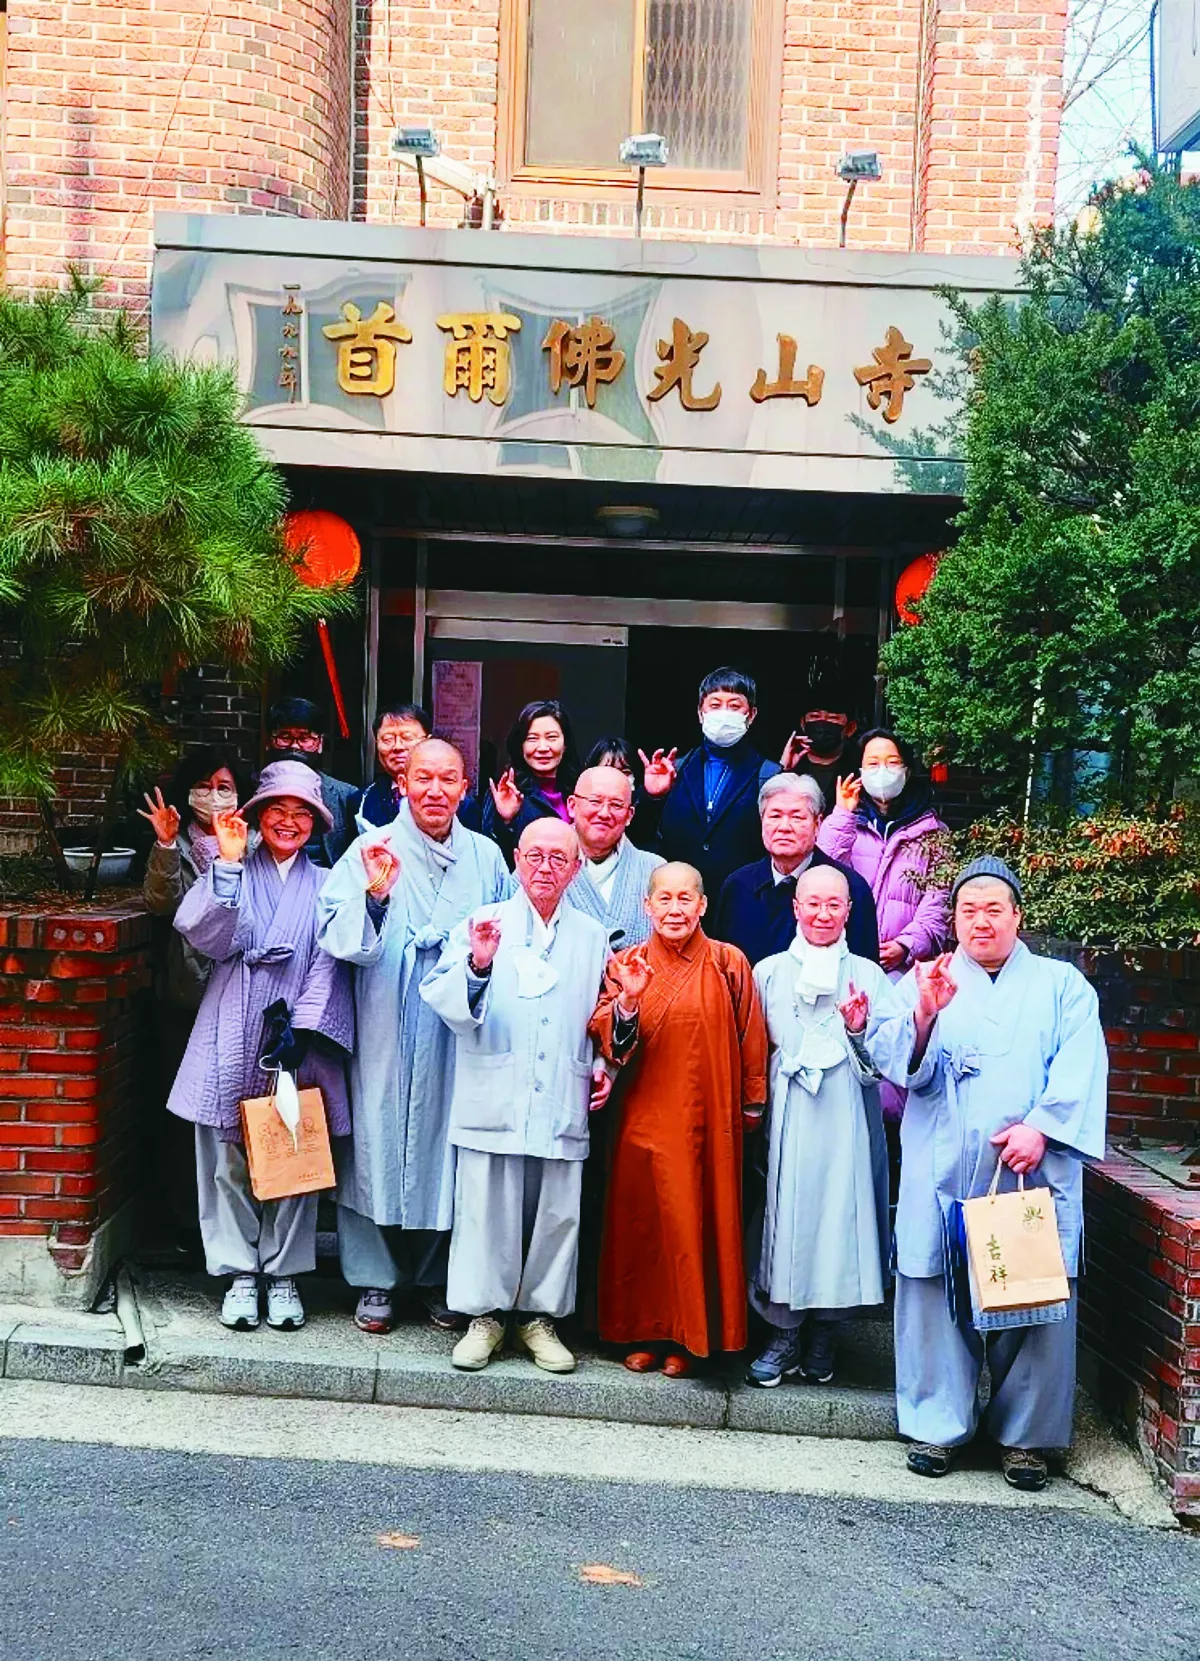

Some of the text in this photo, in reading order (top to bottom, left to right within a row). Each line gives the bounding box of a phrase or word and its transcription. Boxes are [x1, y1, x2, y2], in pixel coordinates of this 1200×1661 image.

[322, 301, 933, 424] 首爾佛光山寺
[986, 1233, 1008, 1291] 吉祥
